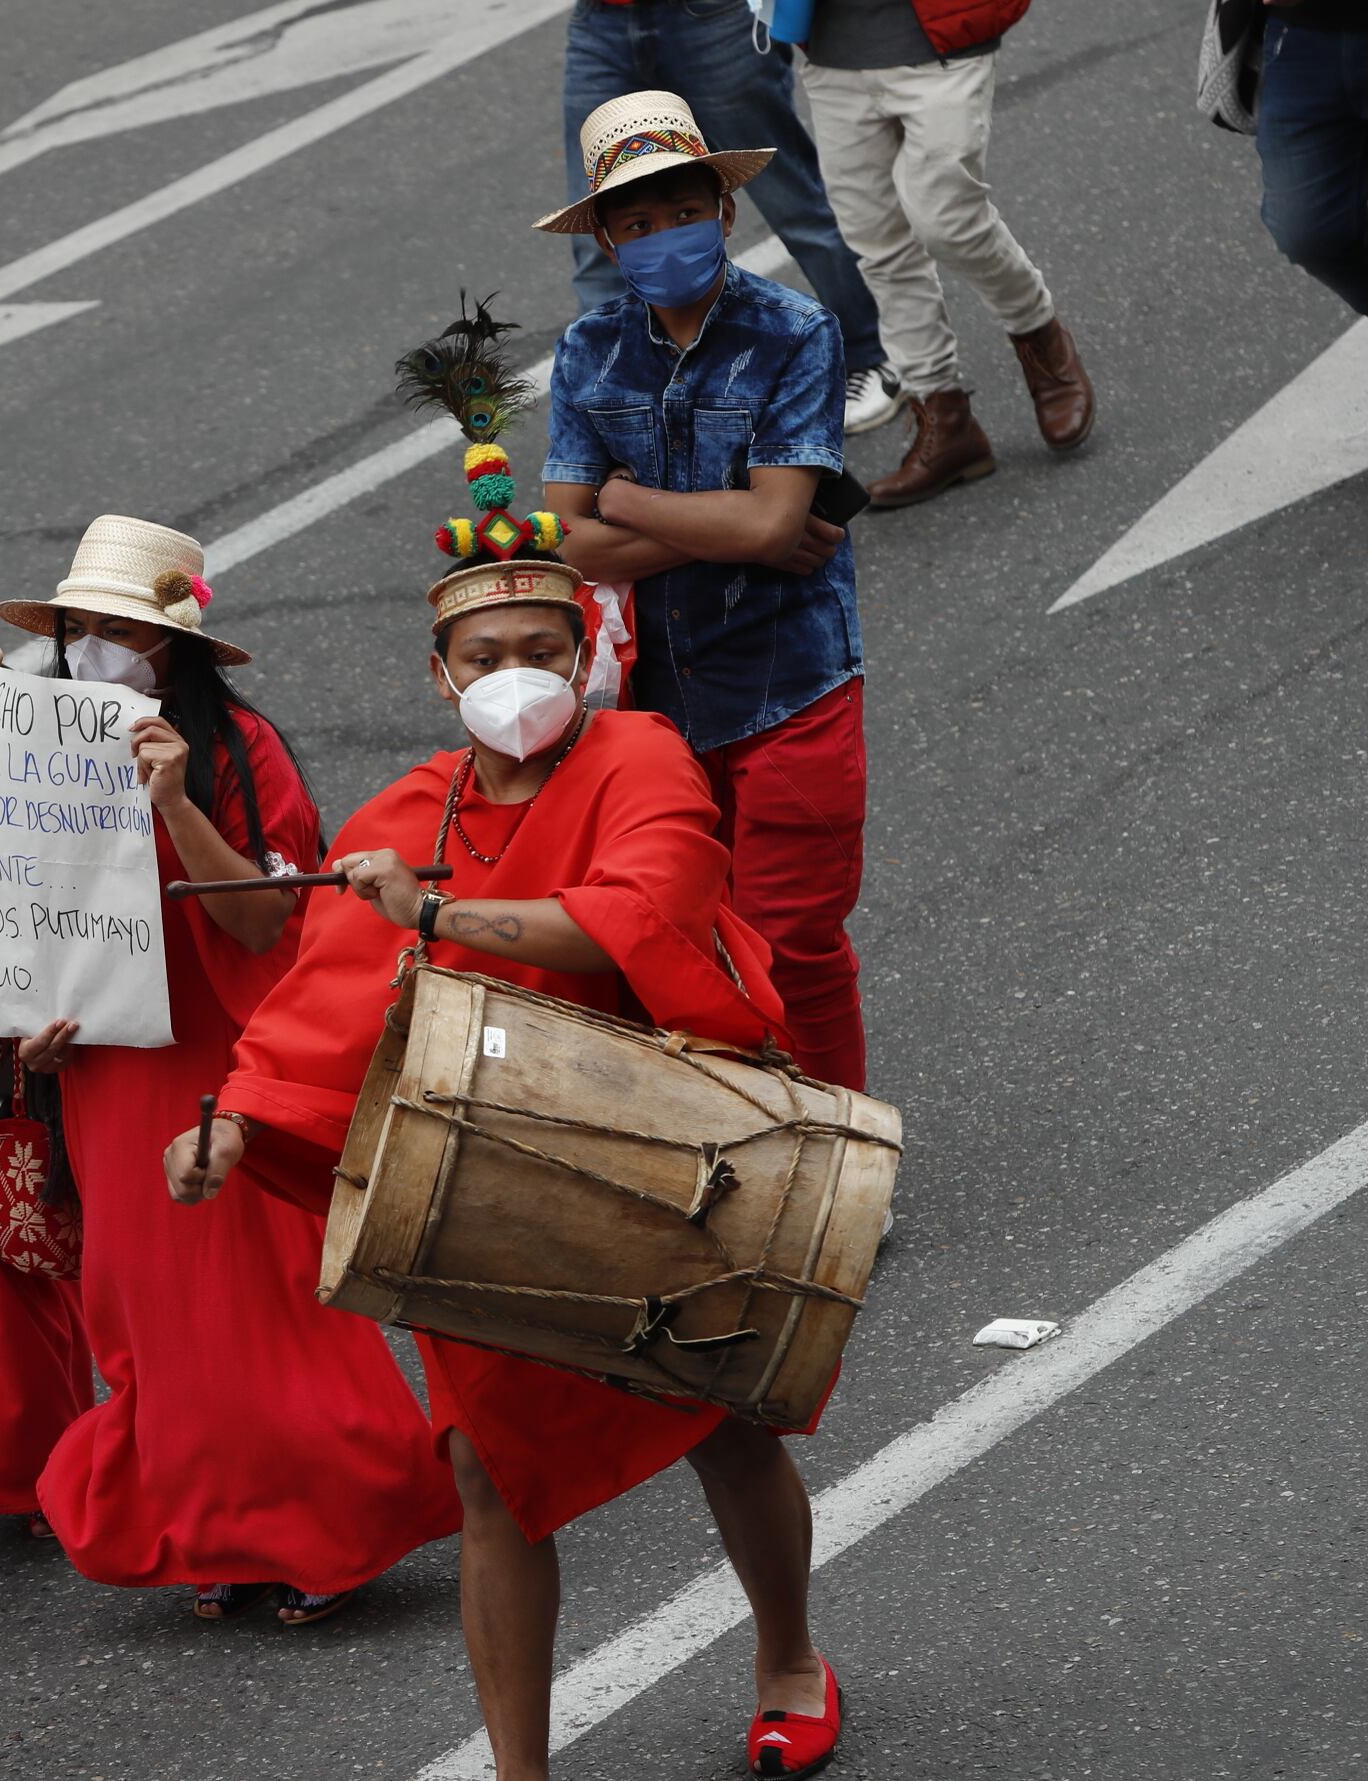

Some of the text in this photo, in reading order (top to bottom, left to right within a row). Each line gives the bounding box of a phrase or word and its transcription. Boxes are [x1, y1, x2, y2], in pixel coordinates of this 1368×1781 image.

[53, 693, 122, 747] POR
[8, 742, 41, 784] LA
[25, 796, 151, 839] DESNUTRICIÓN
[30, 902, 151, 956] PUTUMAYO
